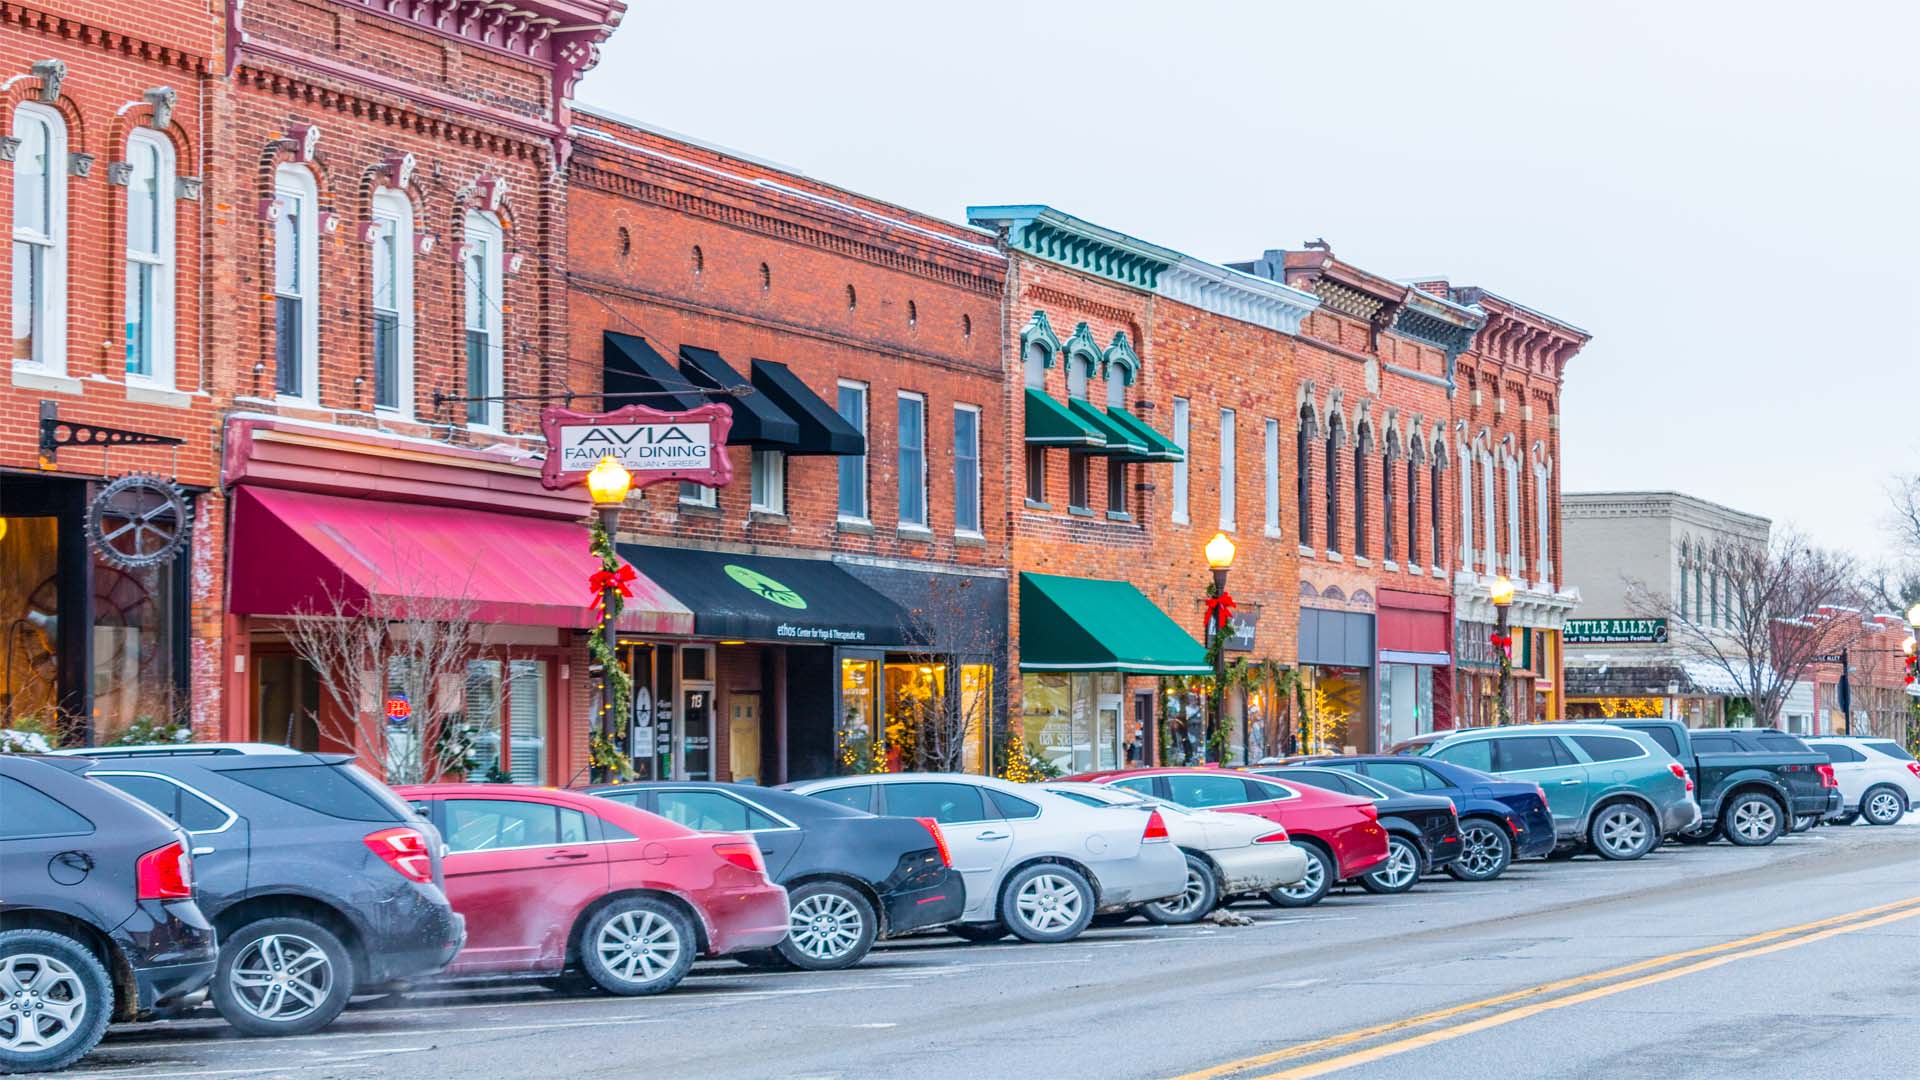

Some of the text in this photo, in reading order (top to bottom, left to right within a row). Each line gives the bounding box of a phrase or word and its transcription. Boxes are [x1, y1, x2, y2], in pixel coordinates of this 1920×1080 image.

[577, 426, 694, 445] AVIA
[565, 445, 706, 459] FAMILY DINING
[777, 622, 796, 637] ethos
[1562, 620, 1656, 634] ATTLE ALLEY
